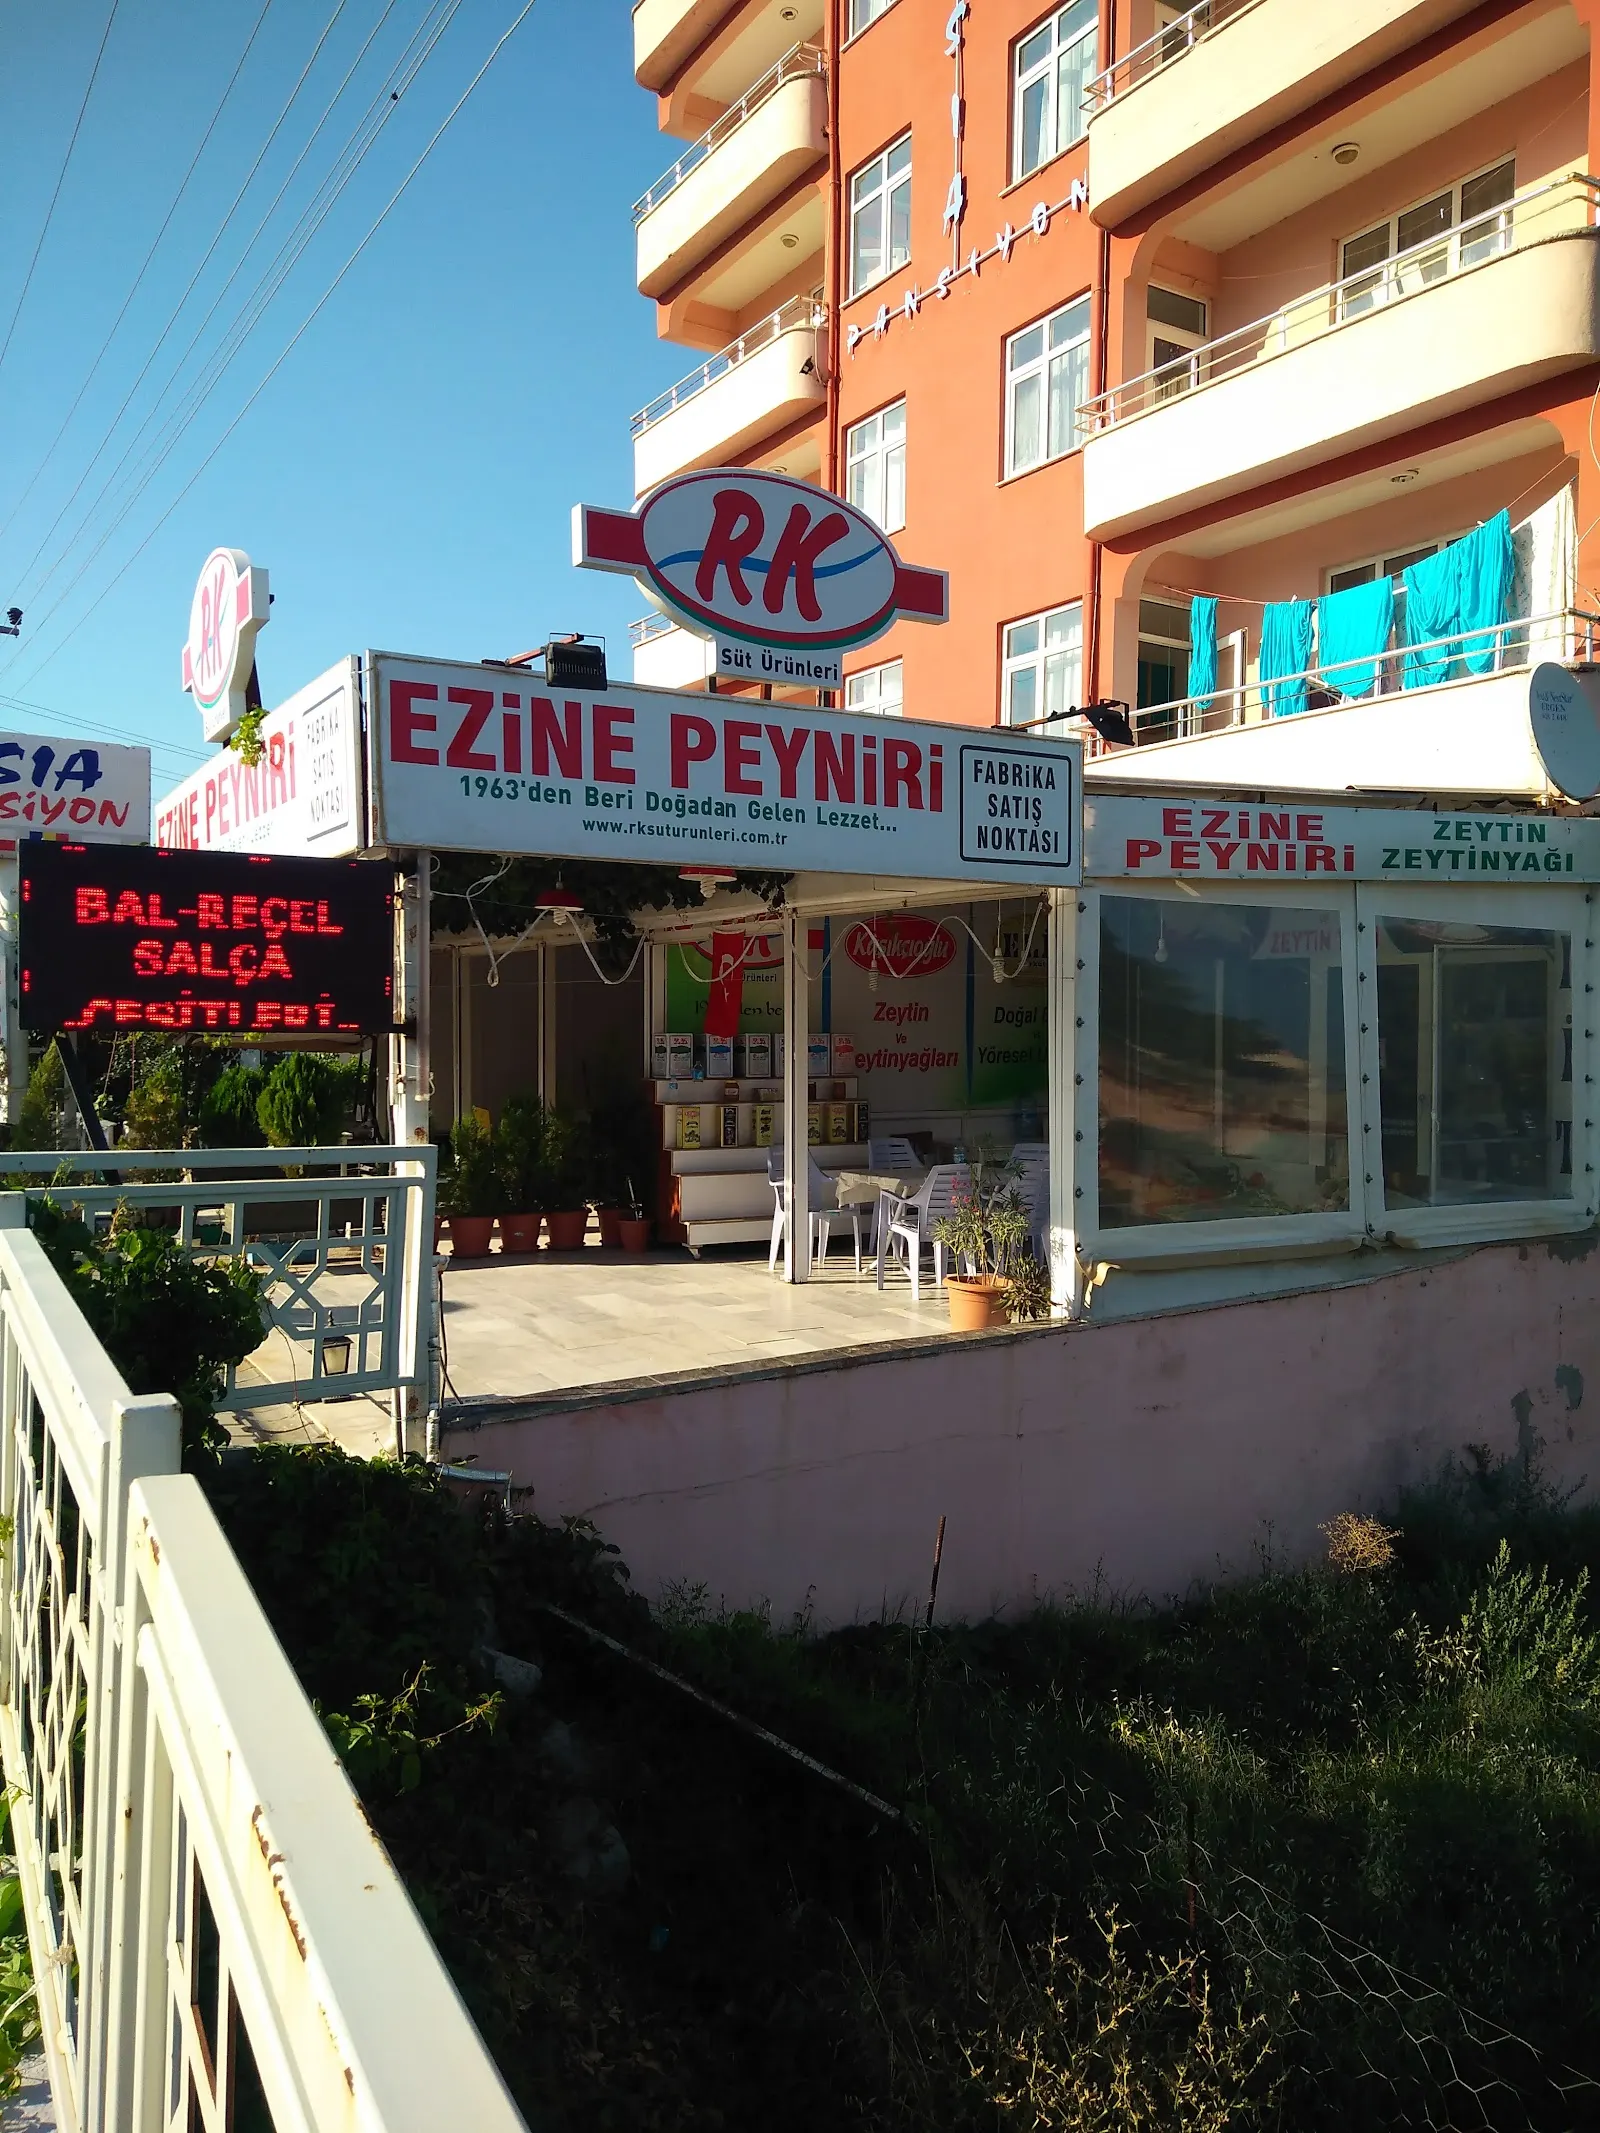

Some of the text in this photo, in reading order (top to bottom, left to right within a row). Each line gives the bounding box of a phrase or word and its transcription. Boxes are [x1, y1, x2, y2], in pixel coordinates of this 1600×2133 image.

[695, 489, 849, 622] RK
[201, 564, 226, 686] RK
[721, 647, 838, 681] Süt Ürünleri
[460, 775, 897, 832] 1963'den Beri Doğadan Gelen Lezzet...
[988, 794, 1042, 827] SATIŞ
[583, 818, 788, 846] www.rksuturunleri.com.tr
[976, 826, 1059, 854] NOKTASI
[1382, 846, 1574, 872] ZEYTİNYAĞI
[76, 887, 344, 939] BAL-REÇEL
[133, 940, 293, 987] SALÇA
[873, 1001, 929, 1026] Zeytin
[994, 1005, 1037, 1029] Doğal
[854, 1045, 959, 1073] eytinyağları
